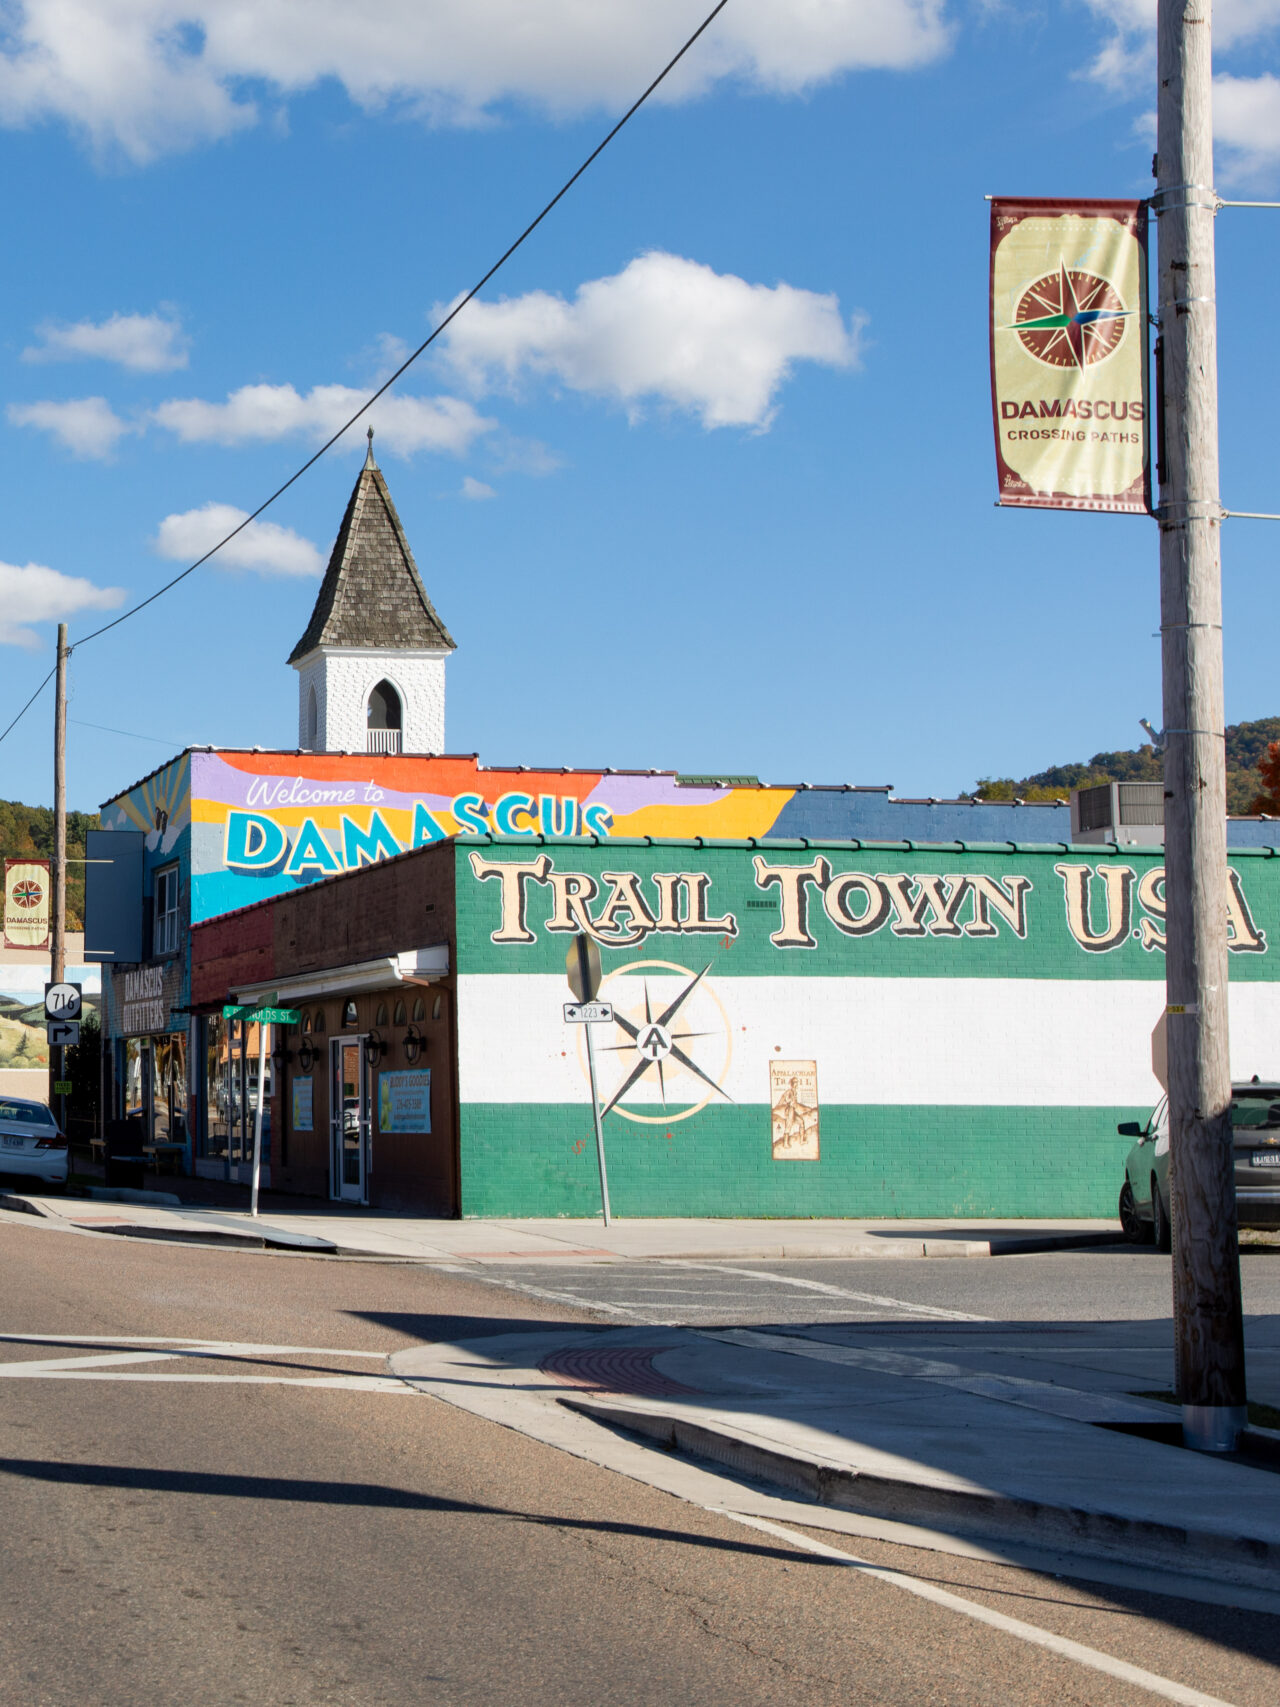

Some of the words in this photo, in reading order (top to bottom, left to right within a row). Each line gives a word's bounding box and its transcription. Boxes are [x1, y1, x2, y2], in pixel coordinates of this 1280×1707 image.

[1001, 399, 1145, 421] DAMASCUS
[1007, 429, 1086, 441] CROSSING
[1091, 432, 1140, 443] PATHS
[246, 776, 356, 806] Welcome
[363, 779, 385, 801] to
[223, 790, 613, 876] DAMASCUS
[469, 852, 739, 949] TRAIL
[752, 855, 1033, 949] TOWN
[6, 917, 48, 925] DAMASCUS
[125, 966, 163, 1002] DAMASCUS
[53, 993, 74, 1010] 716
[123, 1000, 164, 1033] OUTFITTERS
[233, 1007, 277, 1021] RNOLDS
[280, 1012, 291, 1021] ST
[580, 1007, 598, 1018] 1223
[771, 1069, 816, 1077] APPALACHIAN
[775, 1077, 812, 1087] TRIL
